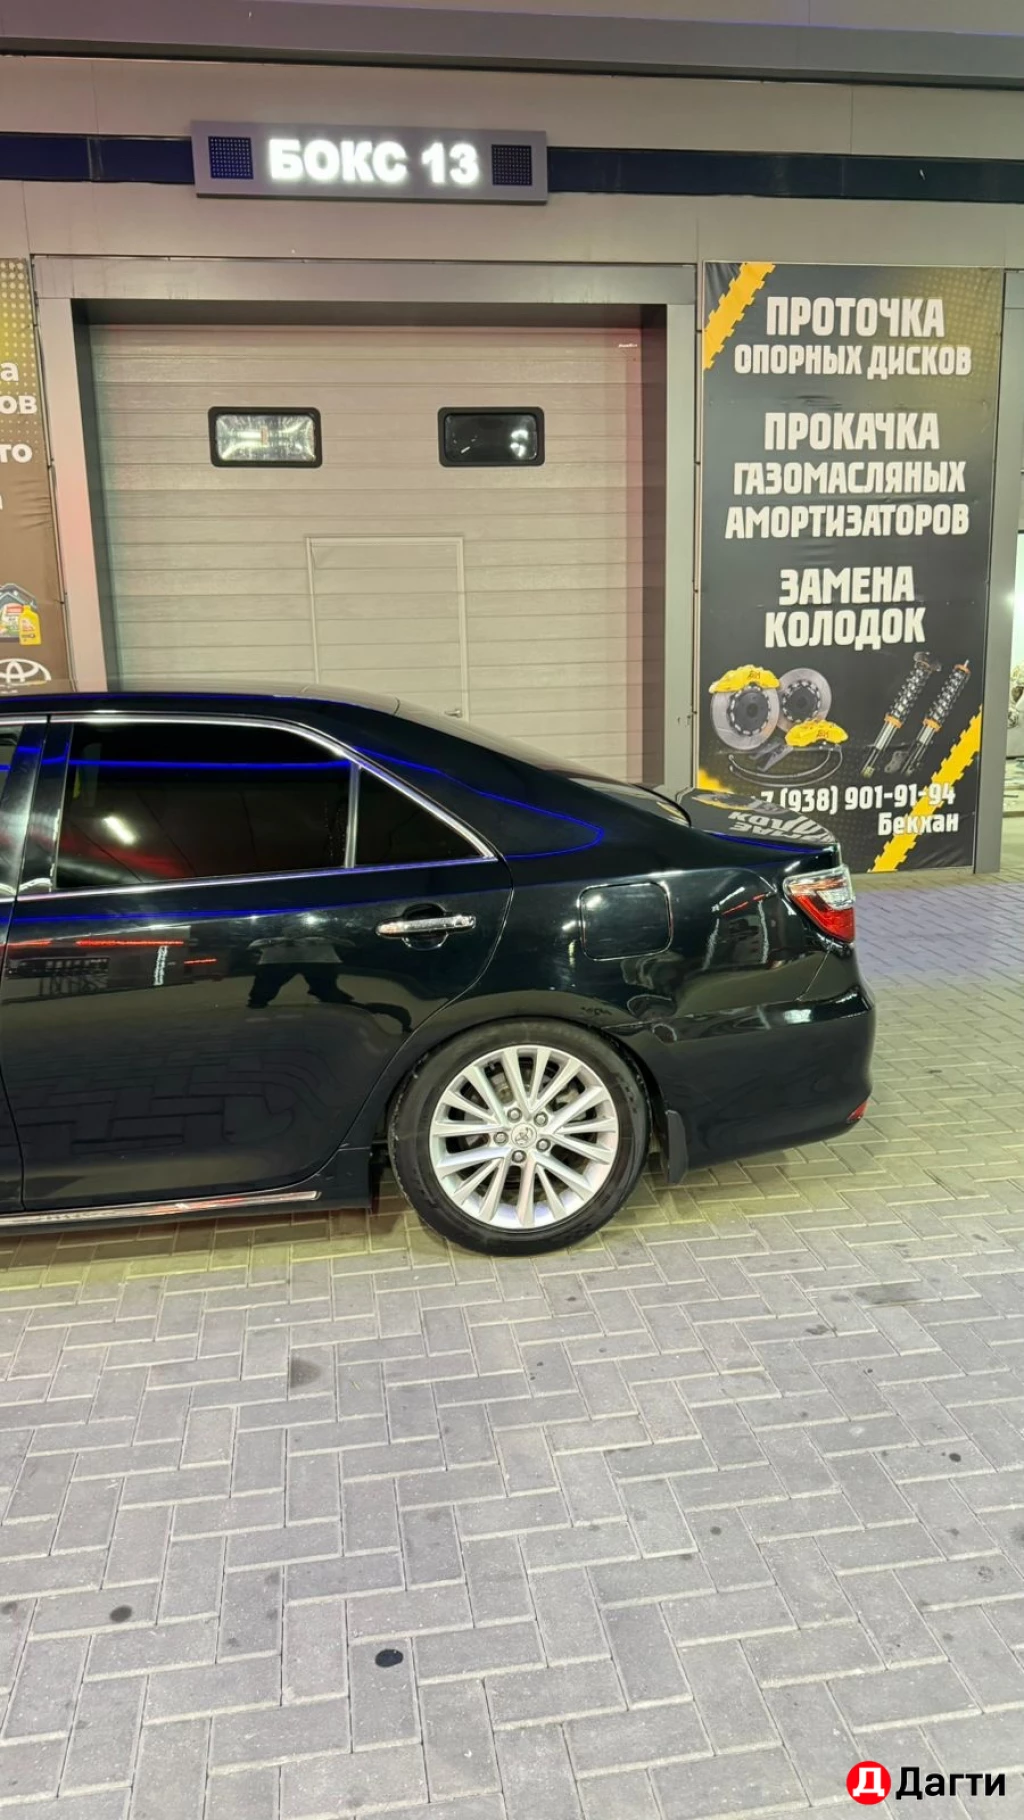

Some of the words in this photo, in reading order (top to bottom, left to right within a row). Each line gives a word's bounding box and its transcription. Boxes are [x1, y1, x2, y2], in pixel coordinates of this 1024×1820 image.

[268, 138, 408, 183] БОКС
[421, 143, 479, 184] 13
[766, 296, 945, 337] ПРОТОЧКА
[734, 344, 862, 375] ОПОРНЫХ
[867, 346, 971, 380] ДИСКОВ
[764, 412, 940, 450] ПРОКАЧКА
[733, 461, 966, 495] ГАЗОМАСЛЯНЫХ
[725, 504, 969, 539] АМОРТИЗАТОРОВ
[779, 566, 915, 605] ЗАМЕНА
[765, 607, 926, 651] КОЛОДОК
[779, 785, 839, 815] (938)
[845, 782, 956, 810] 901-91-94
[878, 812, 959, 836] Бекхан
